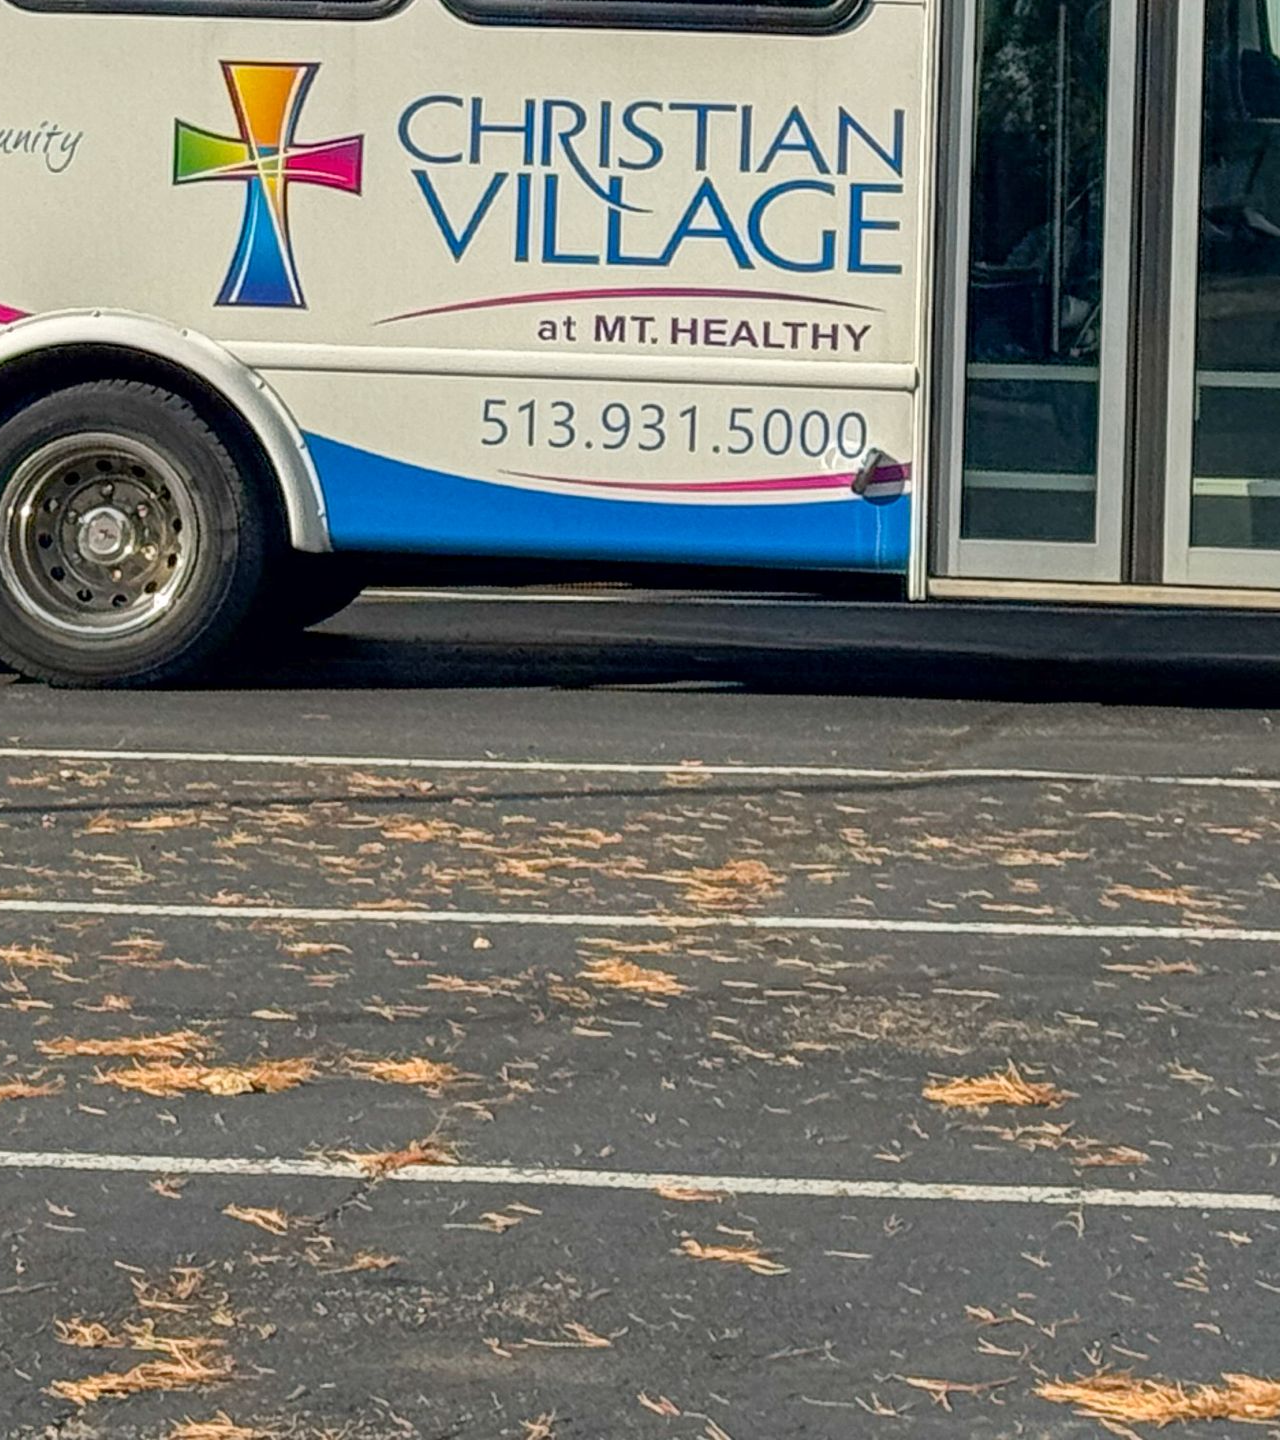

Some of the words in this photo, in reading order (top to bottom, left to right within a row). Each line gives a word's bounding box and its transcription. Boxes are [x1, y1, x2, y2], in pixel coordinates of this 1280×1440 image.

[397, 94, 906, 213] CHRISTIAN
[411, 169, 905, 275] VILLAGE
[537, 315, 577, 343] at
[593, 314, 658, 345] MT.
[670, 317, 873, 352] HEALTHY
[480, 398, 869, 460] 513.931.5000
